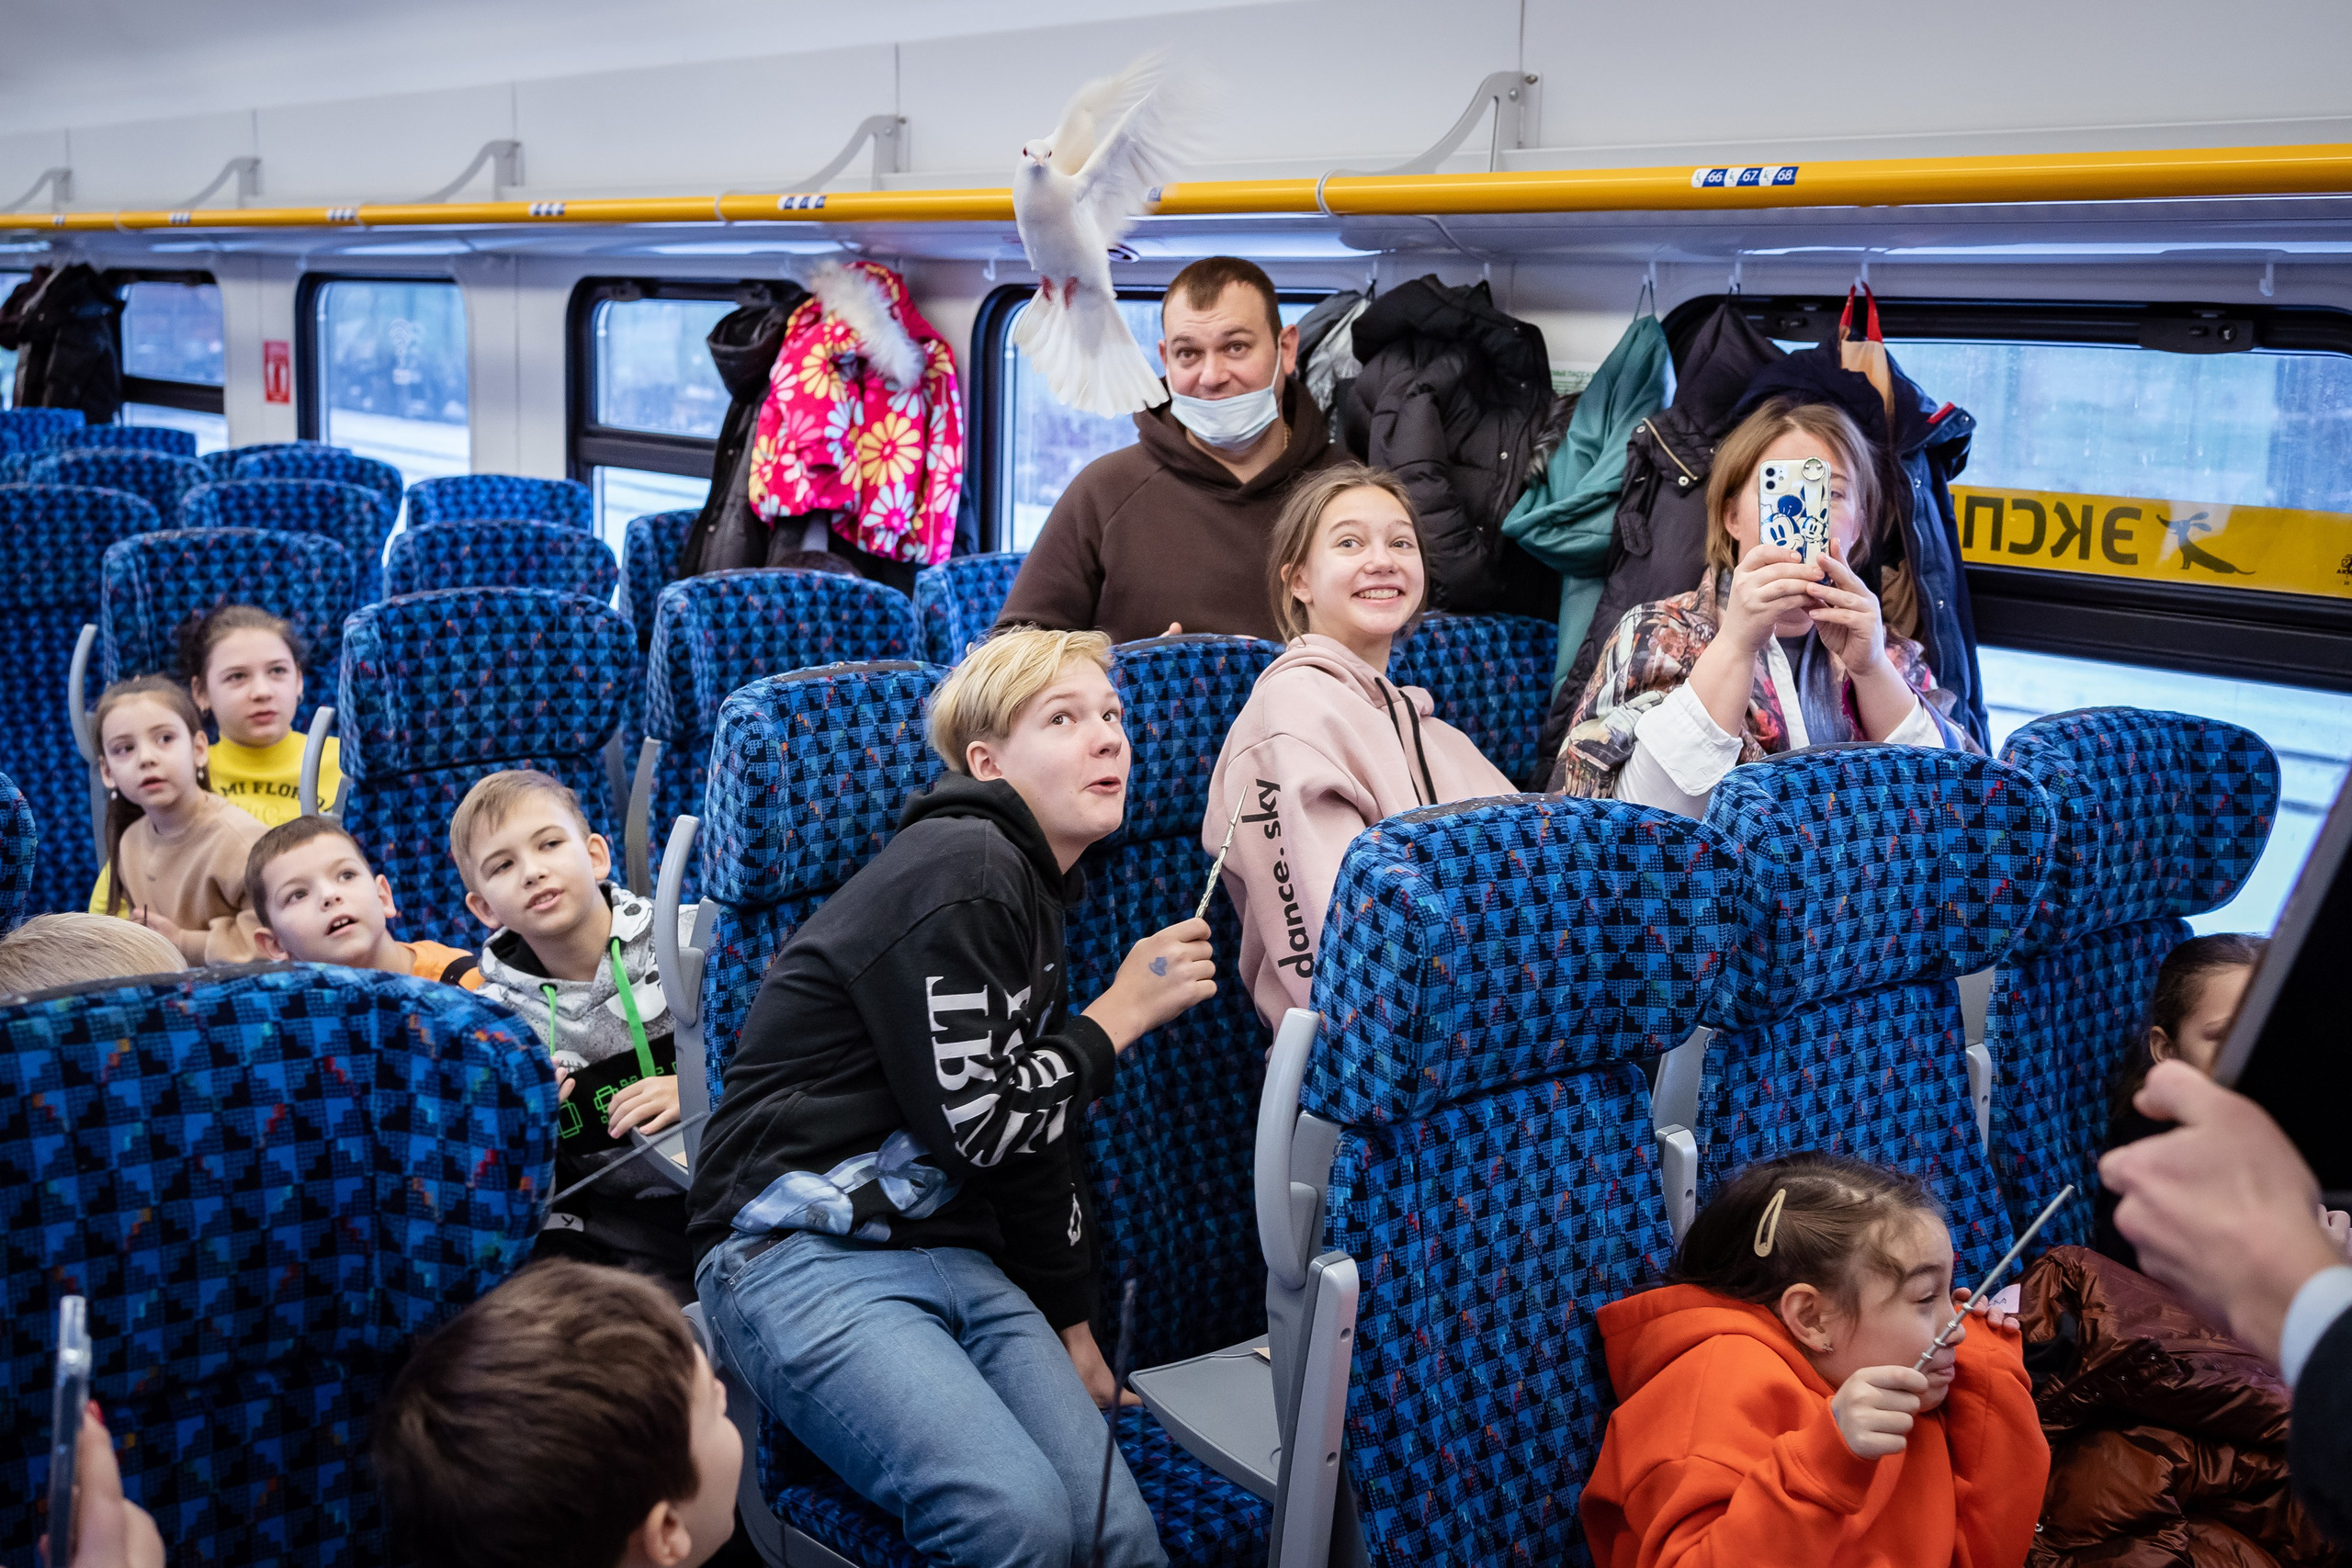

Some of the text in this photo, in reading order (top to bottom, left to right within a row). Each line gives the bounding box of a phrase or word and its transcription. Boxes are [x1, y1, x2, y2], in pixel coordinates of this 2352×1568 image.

[1707, 171, 1724, 184] 66
[1742, 170, 1759, 182] 67
[1777, 169, 1794, 181] 68
